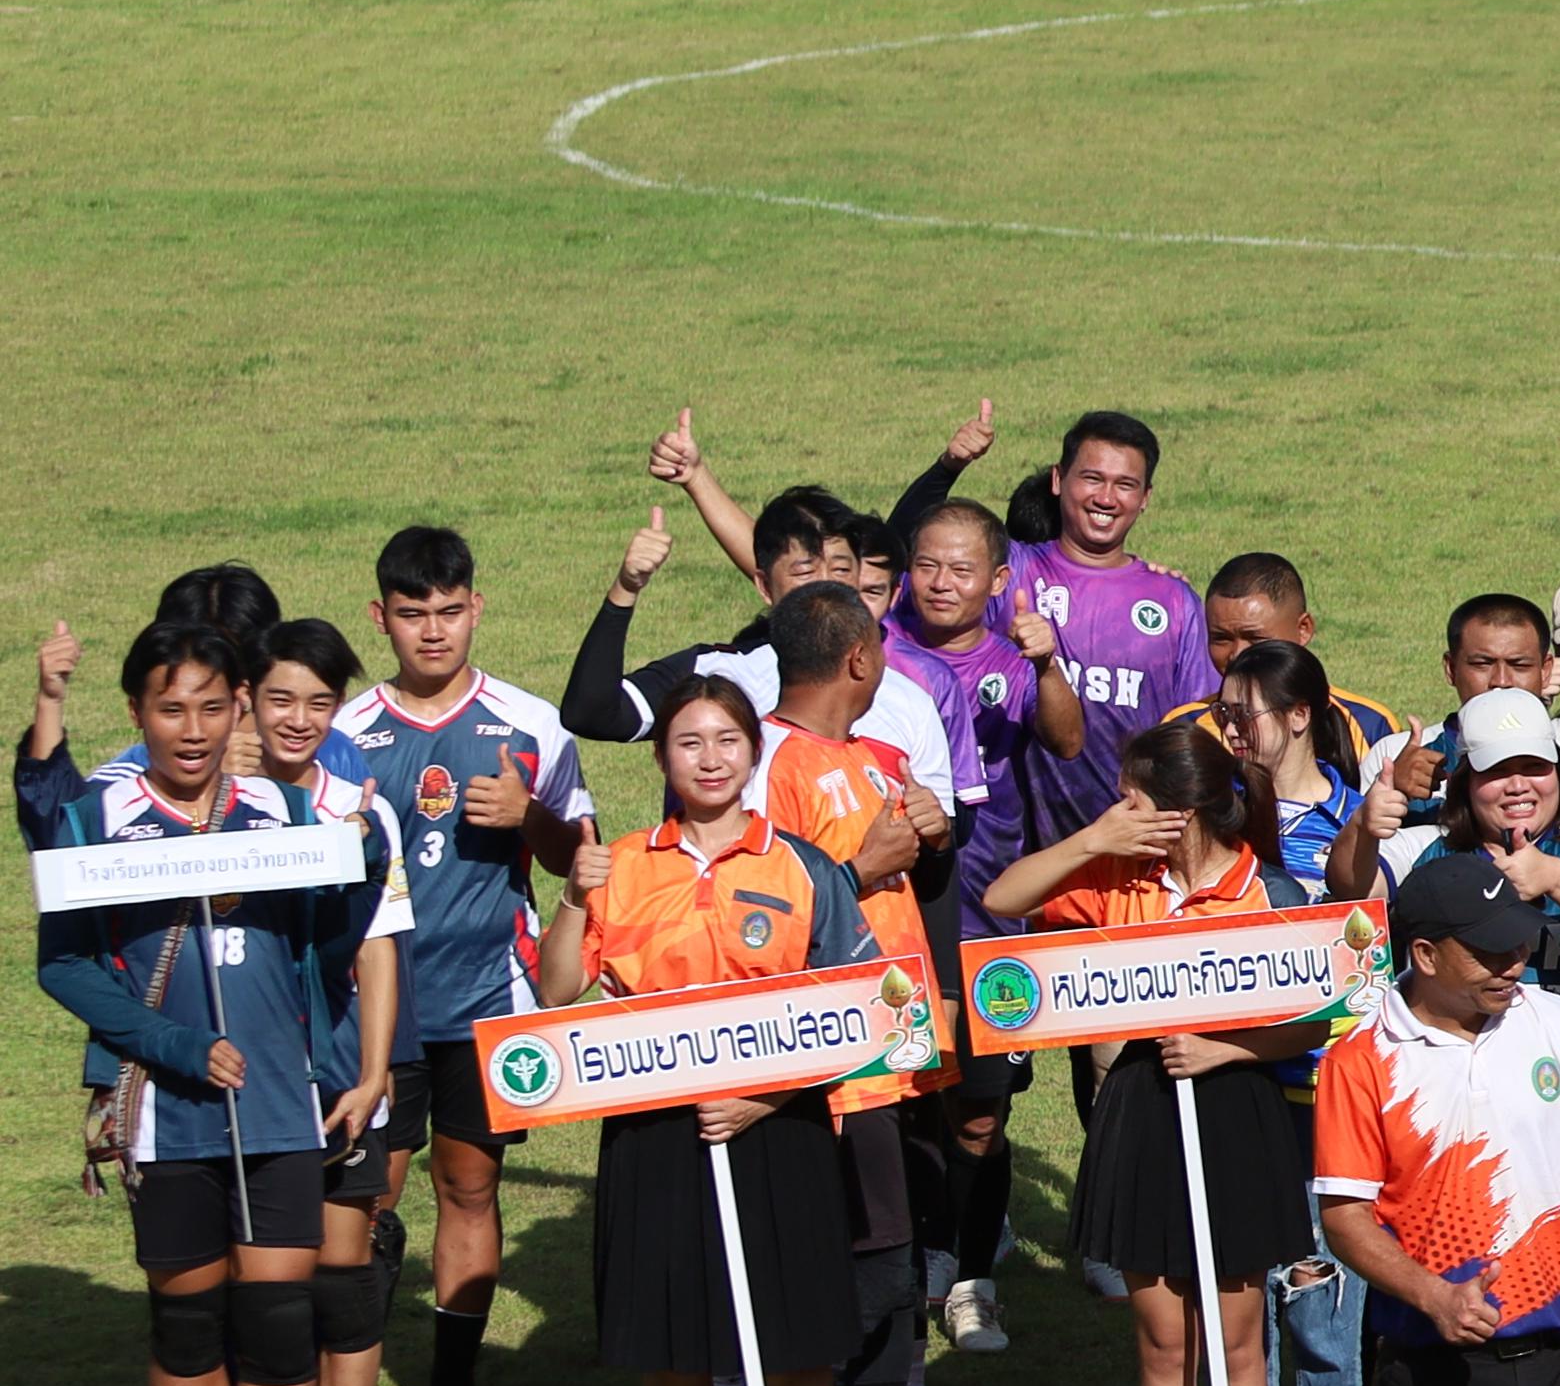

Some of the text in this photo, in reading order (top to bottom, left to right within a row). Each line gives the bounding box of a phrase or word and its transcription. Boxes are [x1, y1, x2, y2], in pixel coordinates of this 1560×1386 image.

[475, 723, 514, 736] TSW
[417, 797, 456, 812] TSW
[816, 768, 862, 819] 77
[78, 848, 325, 884] โรงเรียนท่าสองยางวิทยาคม
[418, 830, 446, 868] 3
[1052, 948, 1333, 1011] หน่วยเฉพาะกิจราชมนู
[569, 1003, 868, 1084] โรงพยาบาลแม่สอด
